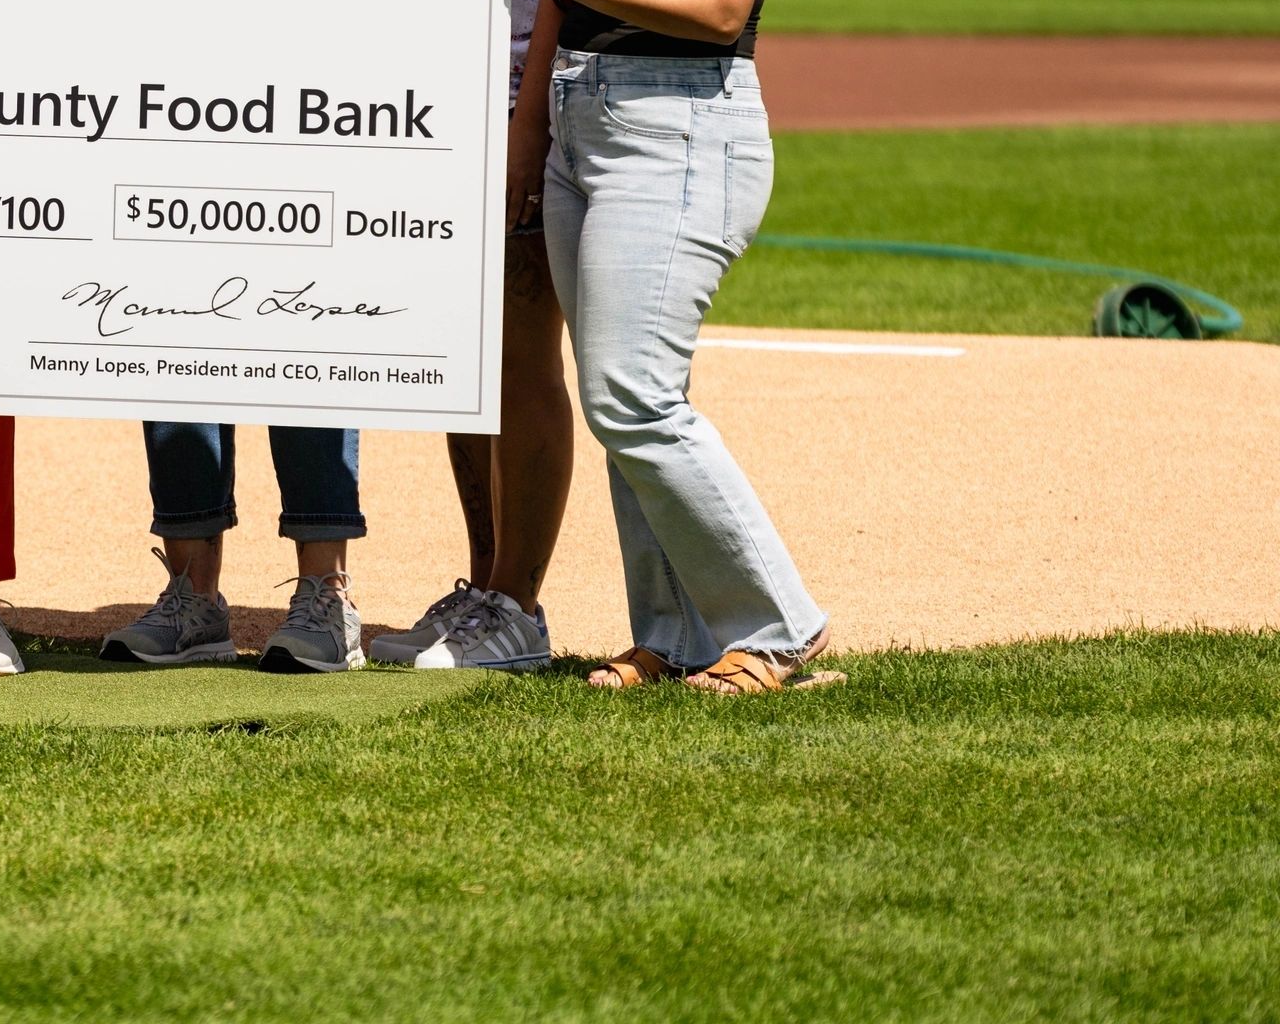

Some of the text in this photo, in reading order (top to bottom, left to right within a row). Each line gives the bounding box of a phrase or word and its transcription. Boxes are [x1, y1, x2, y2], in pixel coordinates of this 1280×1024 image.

[140, 84, 274, 133] Food
[299, 89, 433, 138] Bank
[347, 211, 453, 239] Dollars
[31, 355, 443, 384] Manny Lopes, President and CEO, Fallon Health
